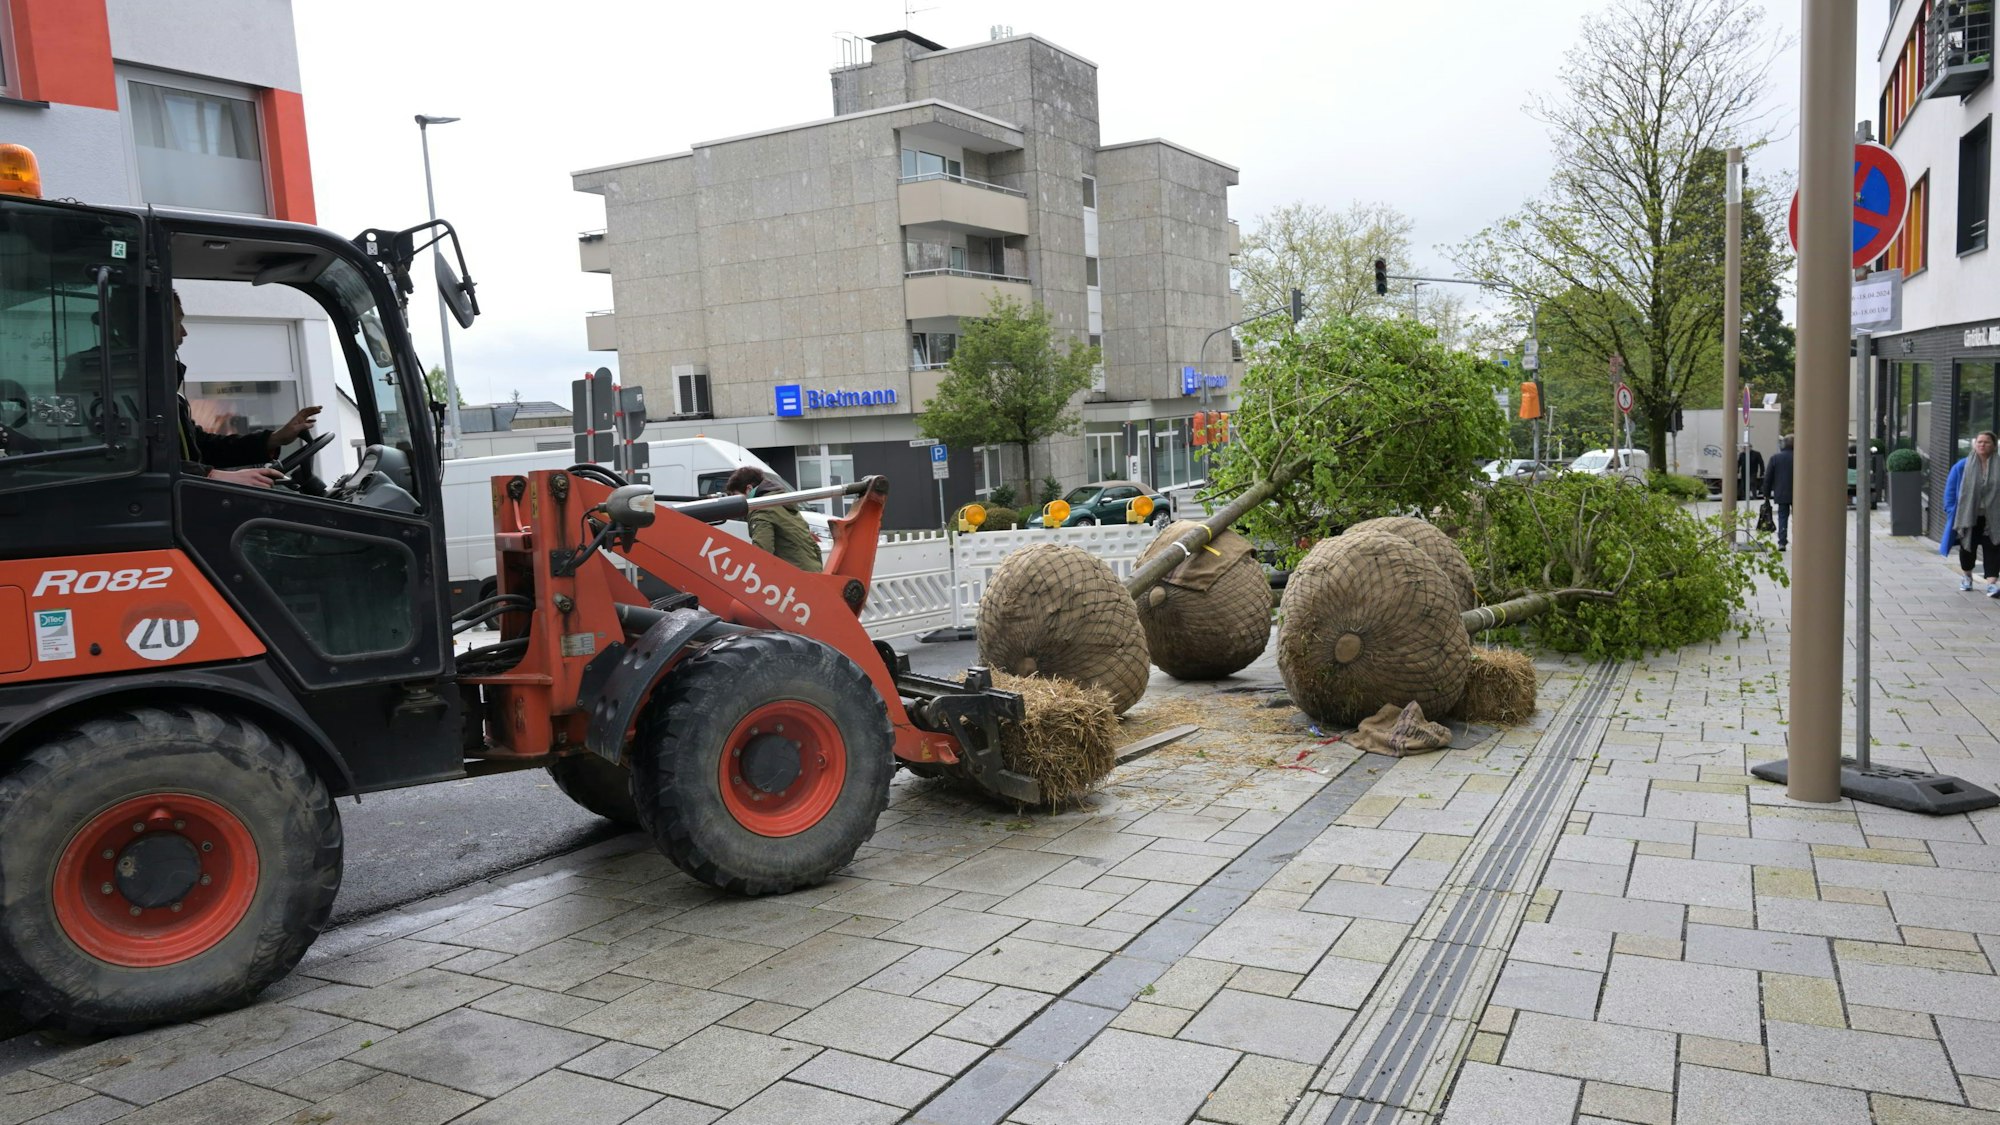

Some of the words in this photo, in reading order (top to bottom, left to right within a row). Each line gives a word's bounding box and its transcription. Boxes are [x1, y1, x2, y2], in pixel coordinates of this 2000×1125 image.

[806, 388, 898, 409] Bietmann
[934, 447, 944, 460] P
[699, 536, 811, 626] Kubota
